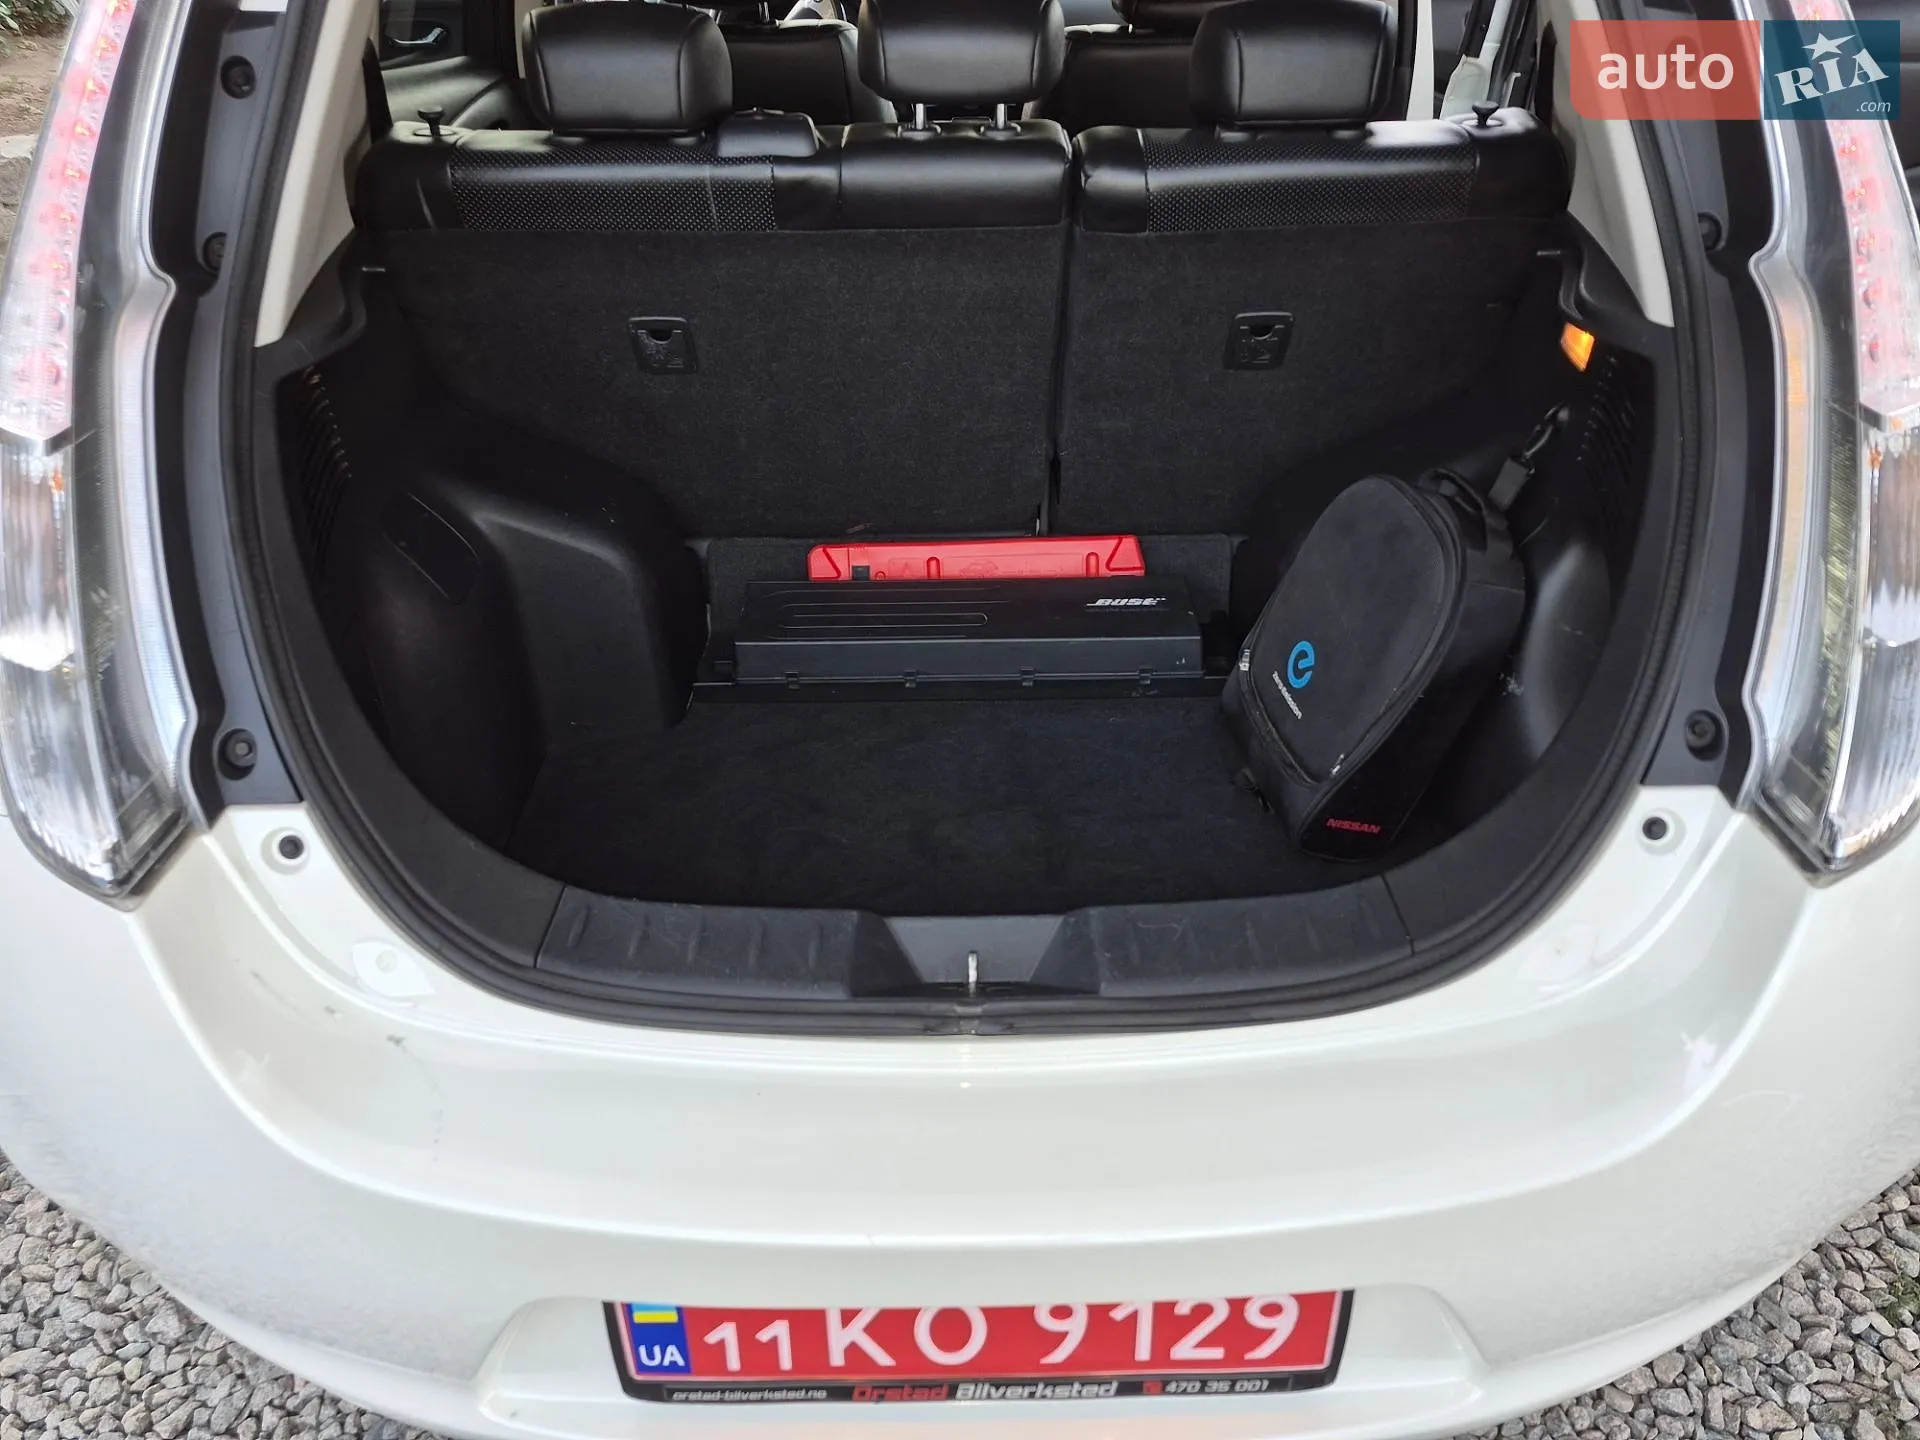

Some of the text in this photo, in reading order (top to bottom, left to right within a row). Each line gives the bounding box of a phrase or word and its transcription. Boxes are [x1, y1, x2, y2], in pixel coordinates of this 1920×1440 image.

[1326, 818, 1381, 834] NISSAN
[703, 1294, 1300, 1371] 11 KO 9129
[638, 1345, 685, 1367] UA
[955, 1380, 1118, 1400] Bilverksted
[1165, 1380, 1202, 1393] 470
[1234, 1379, 1269, 1392] 001
